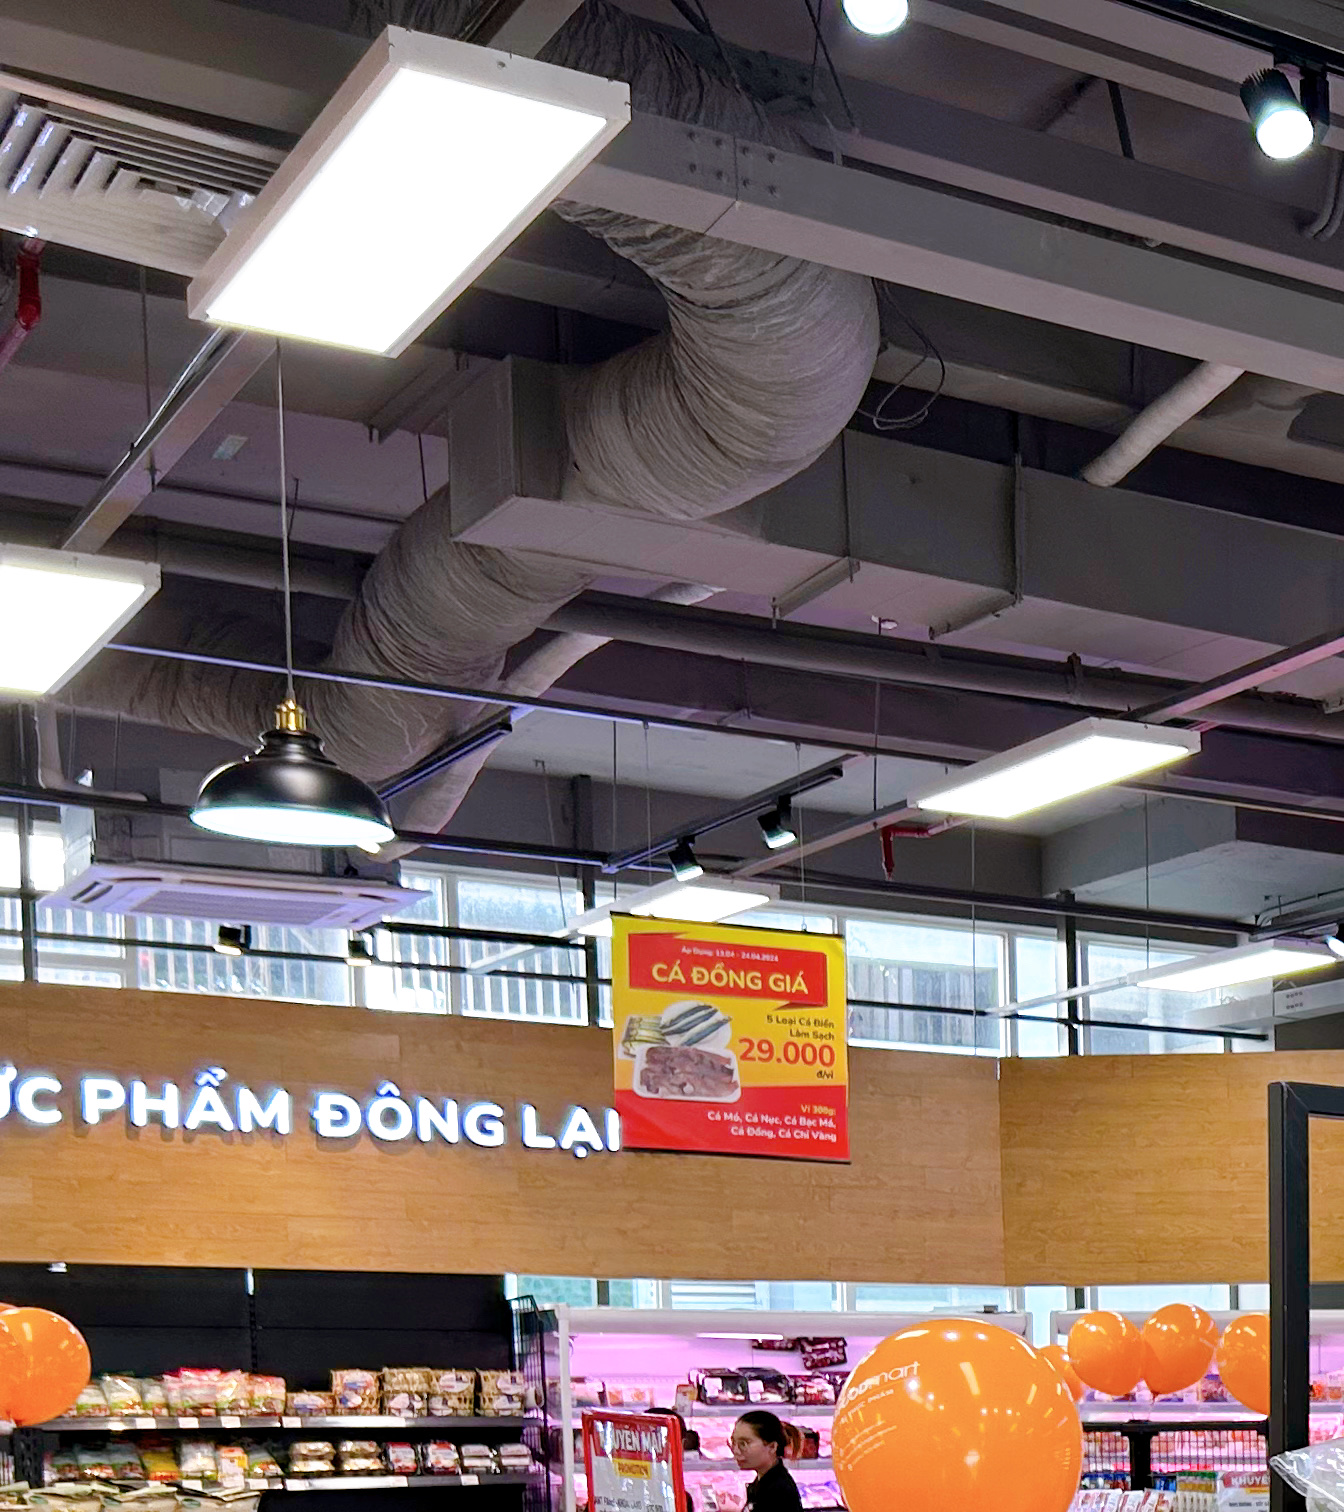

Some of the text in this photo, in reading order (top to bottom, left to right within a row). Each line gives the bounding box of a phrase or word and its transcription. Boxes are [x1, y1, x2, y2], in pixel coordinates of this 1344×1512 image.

[652, 959, 809, 995] CÁ ĐỒNG GIÁ
[738, 1037, 836, 1068] 29.000
[81, 1065, 292, 1136] PHẨM
[312, 1080, 505, 1149] ĐÔNG
[521, 1101, 622, 1160] LẠI
